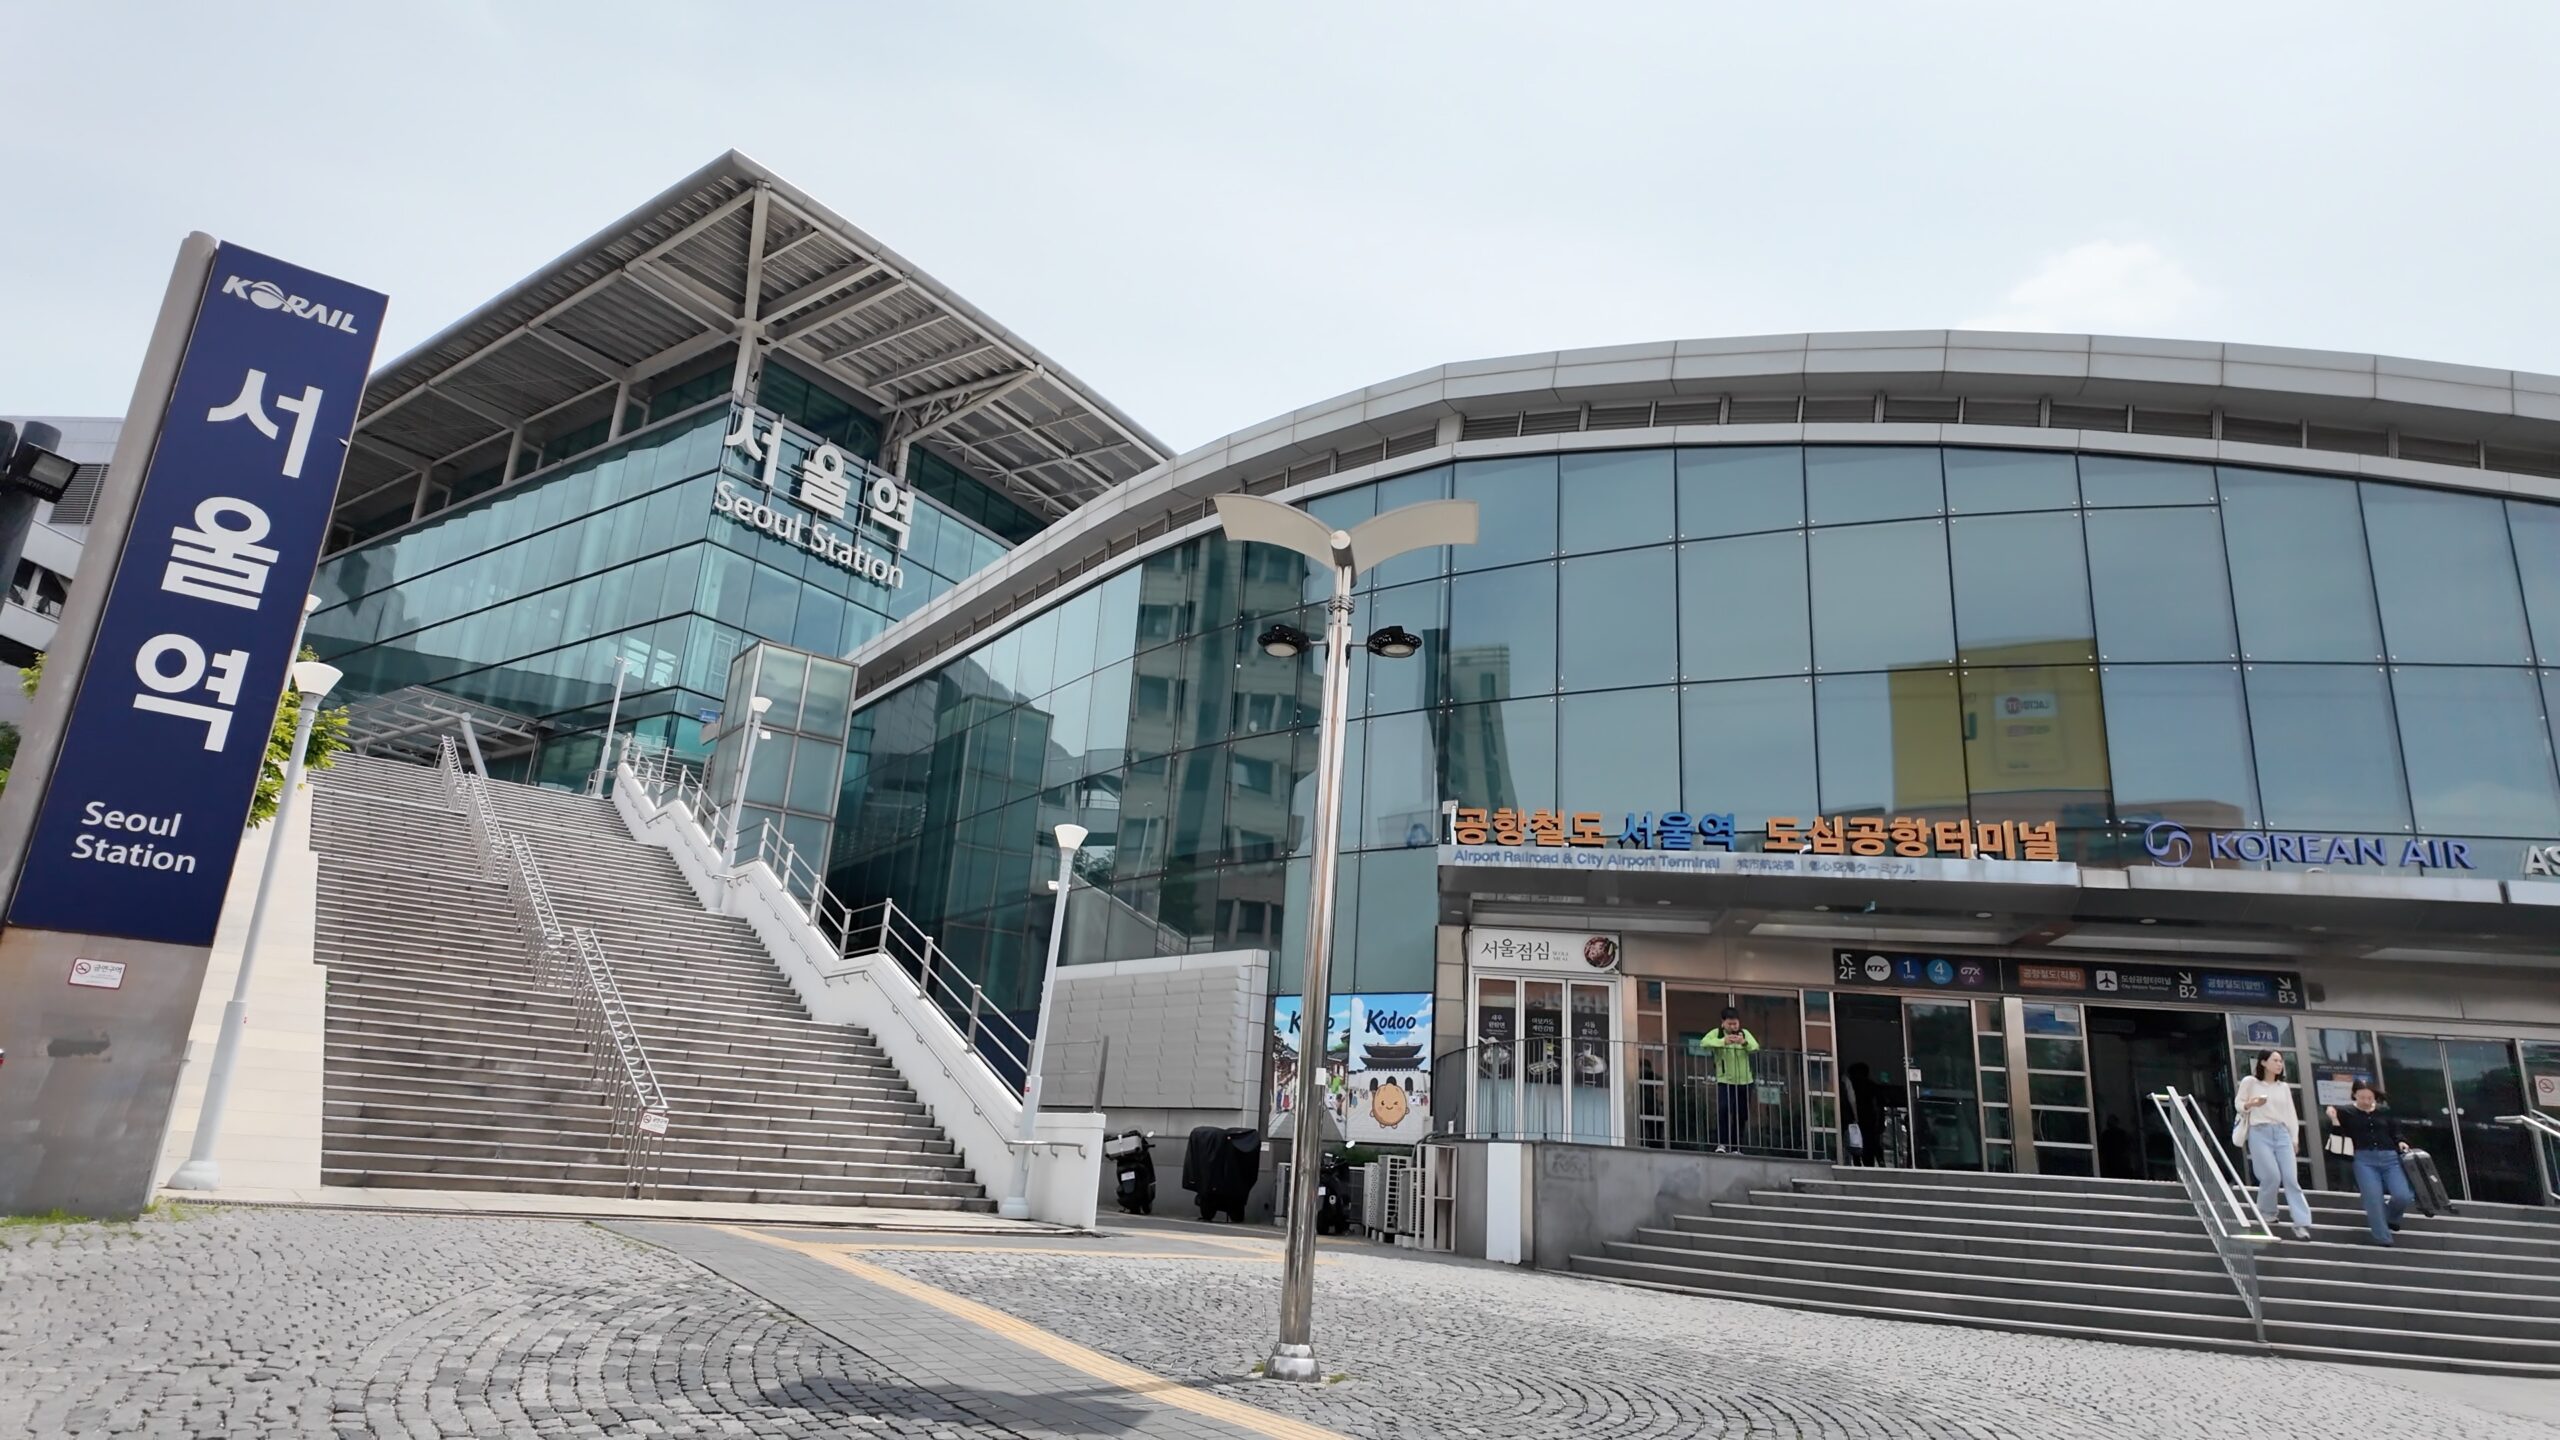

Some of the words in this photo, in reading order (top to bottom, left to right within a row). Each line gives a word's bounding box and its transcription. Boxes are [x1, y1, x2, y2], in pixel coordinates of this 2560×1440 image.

[221, 275, 358, 335] KORAIL
[724, 407, 915, 550] 서울역
[714, 480, 802, 543] Seoul
[810, 523, 904, 589] Station
[133, 368, 324, 752] 서울역
[80, 801, 182, 838] Seoul
[1453, 807, 1607, 846] 공항철도
[1617, 811, 1735, 851] 서울역
[1764, 815, 2060, 862] 도심공항터미널
[71, 834, 196, 874] Station
[1454, 849, 1500, 865] Airport
[1504, 851, 1559, 864] Railroad
[1562, 853, 1573, 865] &
[1577, 853, 1604, 868] City
[1607, 855, 1656, 869] Airport
[1659, 857, 1720, 869] Terminal
[2208, 831, 2388, 866] KOREAN
[2401, 838, 2478, 870] AIR
[1481, 938, 1550, 961] 서울점심
[1839, 966, 1857, 980] 2F
[1866, 964, 1888, 973] KTX
[1904, 960, 1911, 974] 1
[1934, 962, 1945, 975] 4
[1960, 966, 1981, 976] GTX
[2179, 987, 2198, 999] B2
[2278, 990, 2298, 1004] B3
[1365, 1009, 1417, 1035] Kodoo
